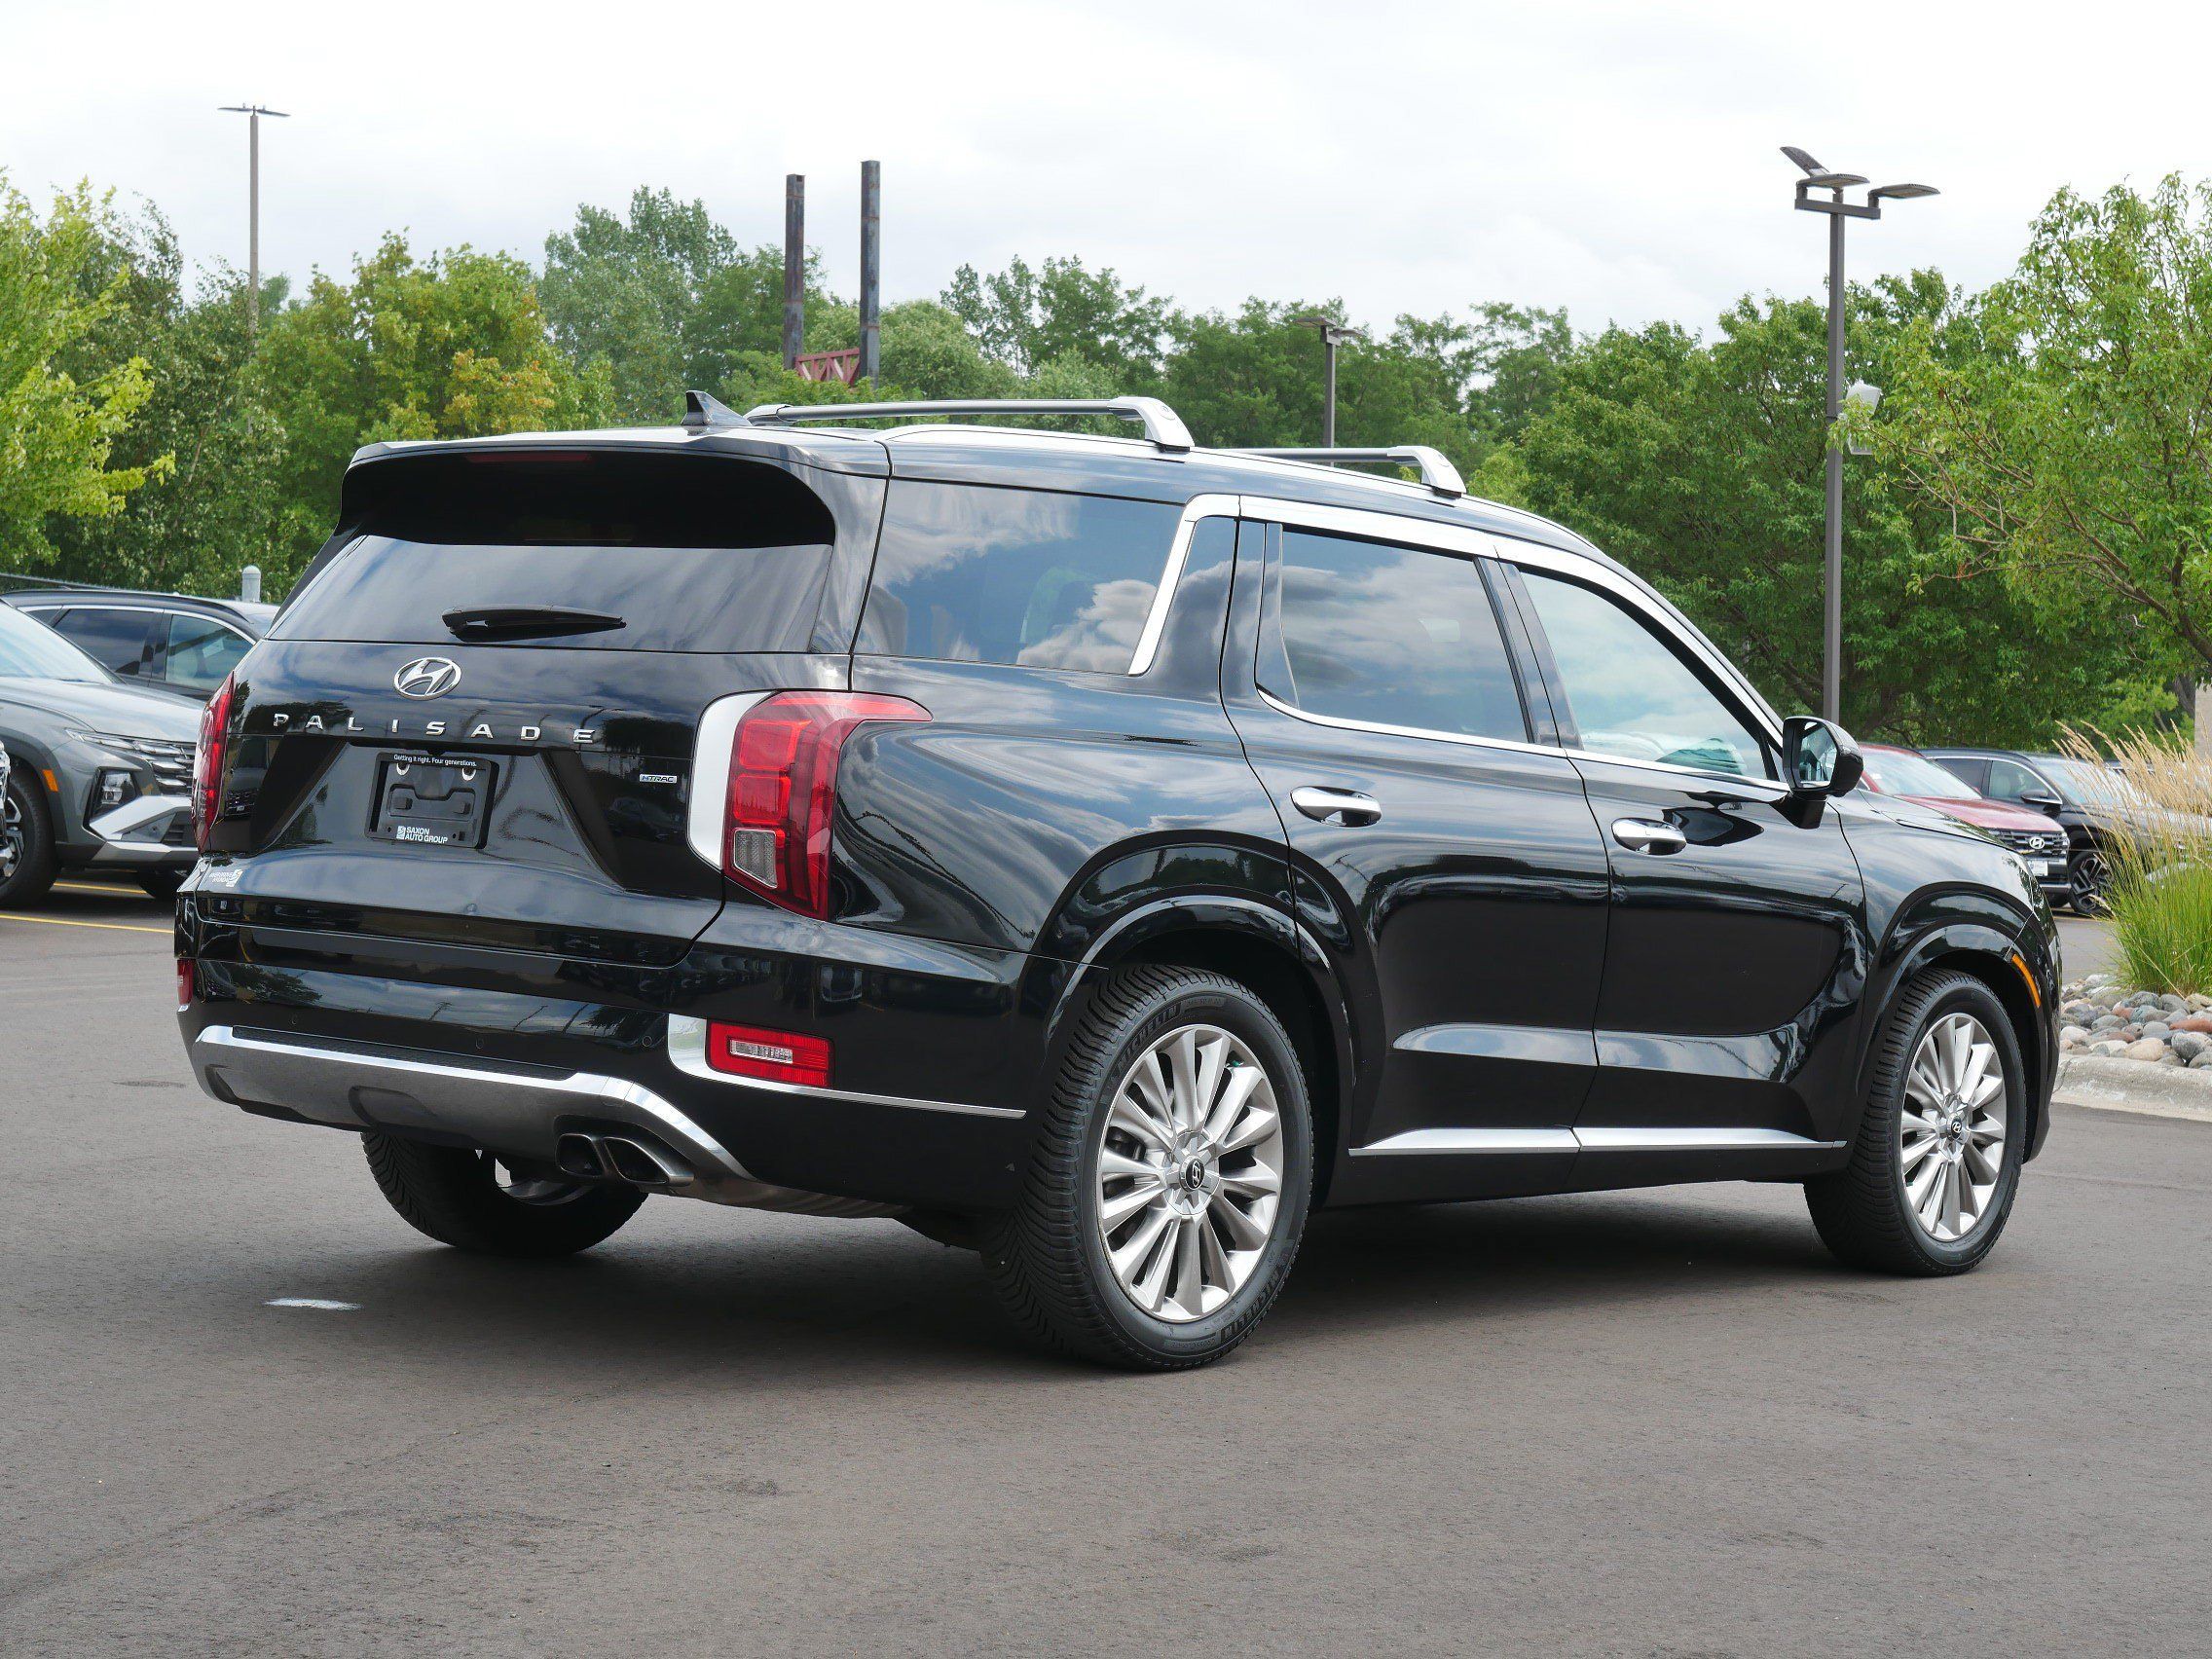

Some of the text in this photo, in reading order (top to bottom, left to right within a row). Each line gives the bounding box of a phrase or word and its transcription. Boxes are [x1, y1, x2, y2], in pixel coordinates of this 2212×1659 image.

[274, 713, 595, 744] PALISADE
[393, 755, 412, 763] Getting
[405, 833, 424, 842] AUTO
[406, 827, 430, 835] SAXON
[1117, 1005, 1179, 1072] MICHELIN
[1222, 1270, 1280, 1339] MICHELIN
